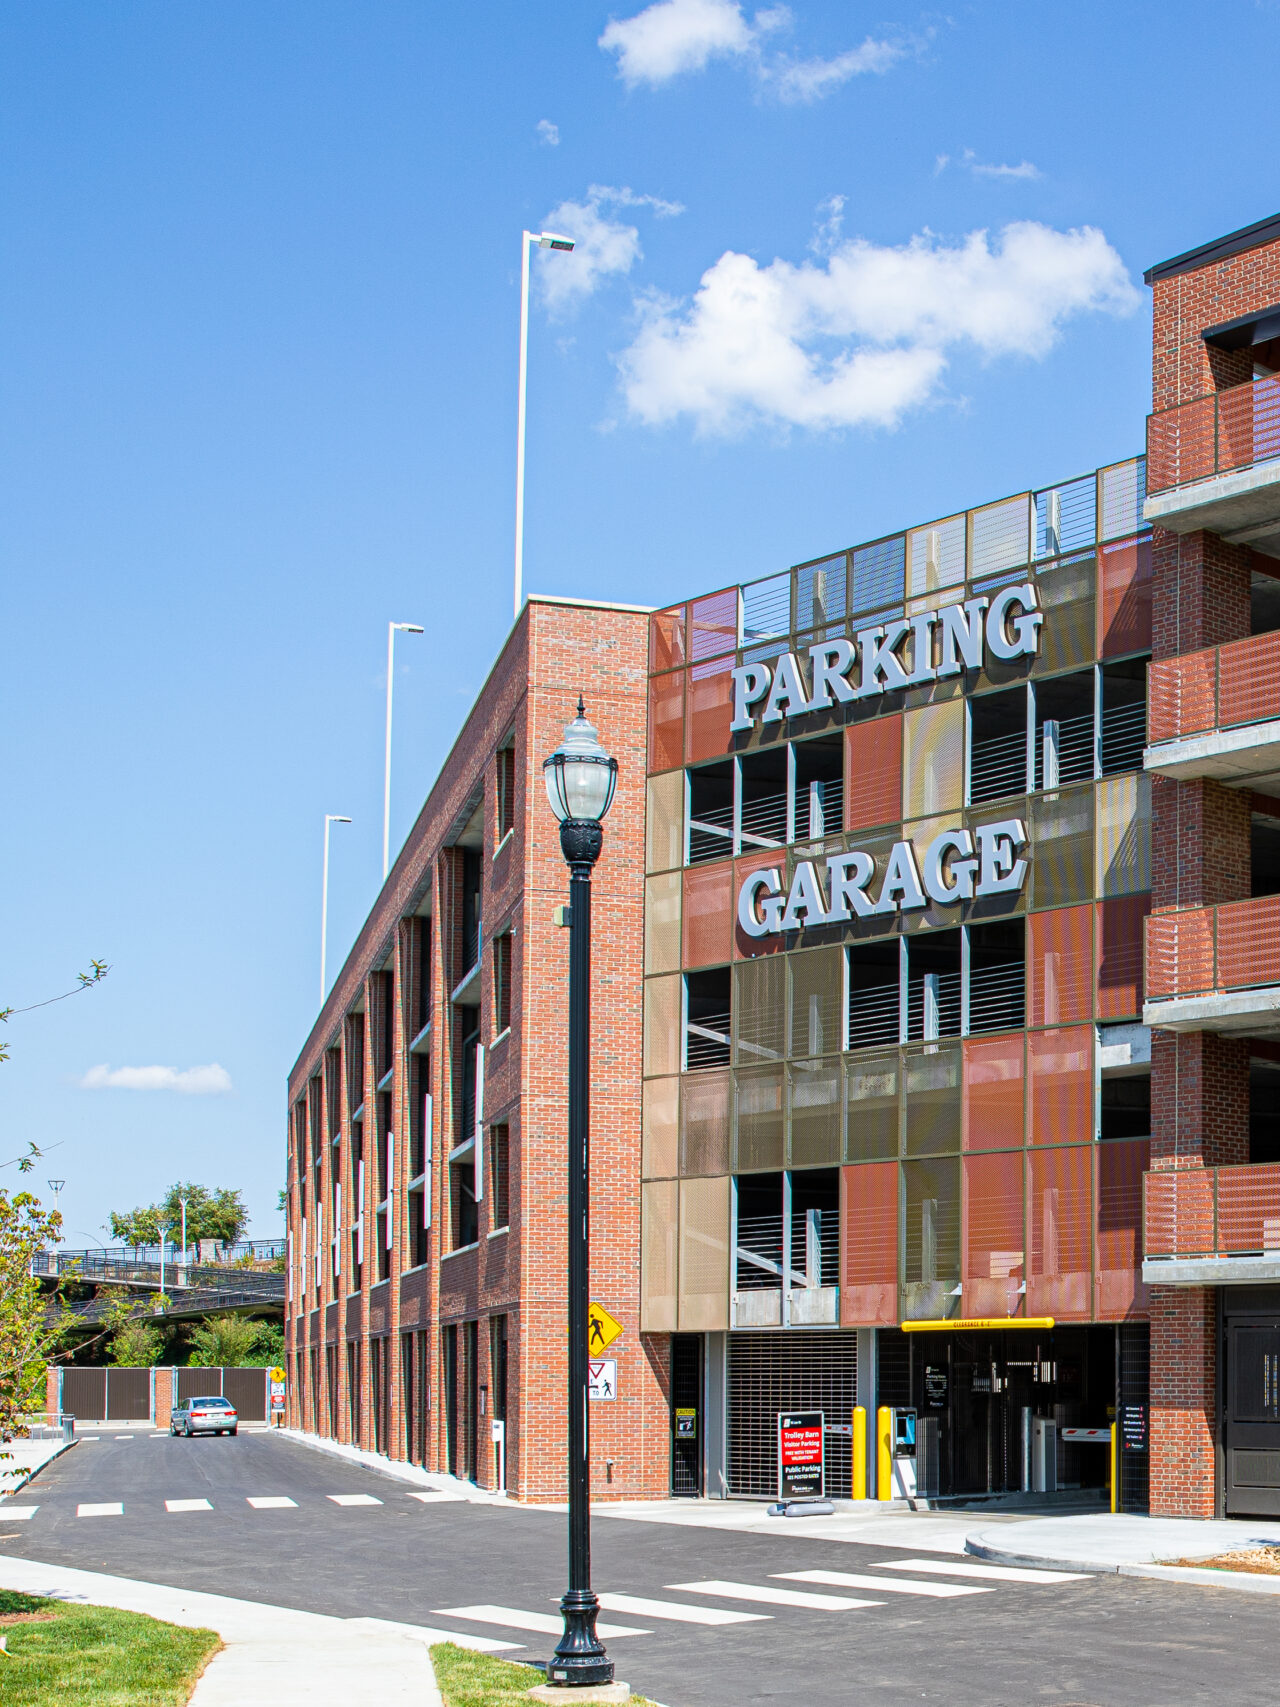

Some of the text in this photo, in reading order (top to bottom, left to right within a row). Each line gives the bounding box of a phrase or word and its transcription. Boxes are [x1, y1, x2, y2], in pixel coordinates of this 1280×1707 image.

[729, 582, 1044, 732] PARKING
[738, 818, 1030, 938] GARAGE
[784, 1432, 804, 1440] Trolley
[801, 1440, 820, 1448] Parking
[801, 1464, 821, 1473] Parking
